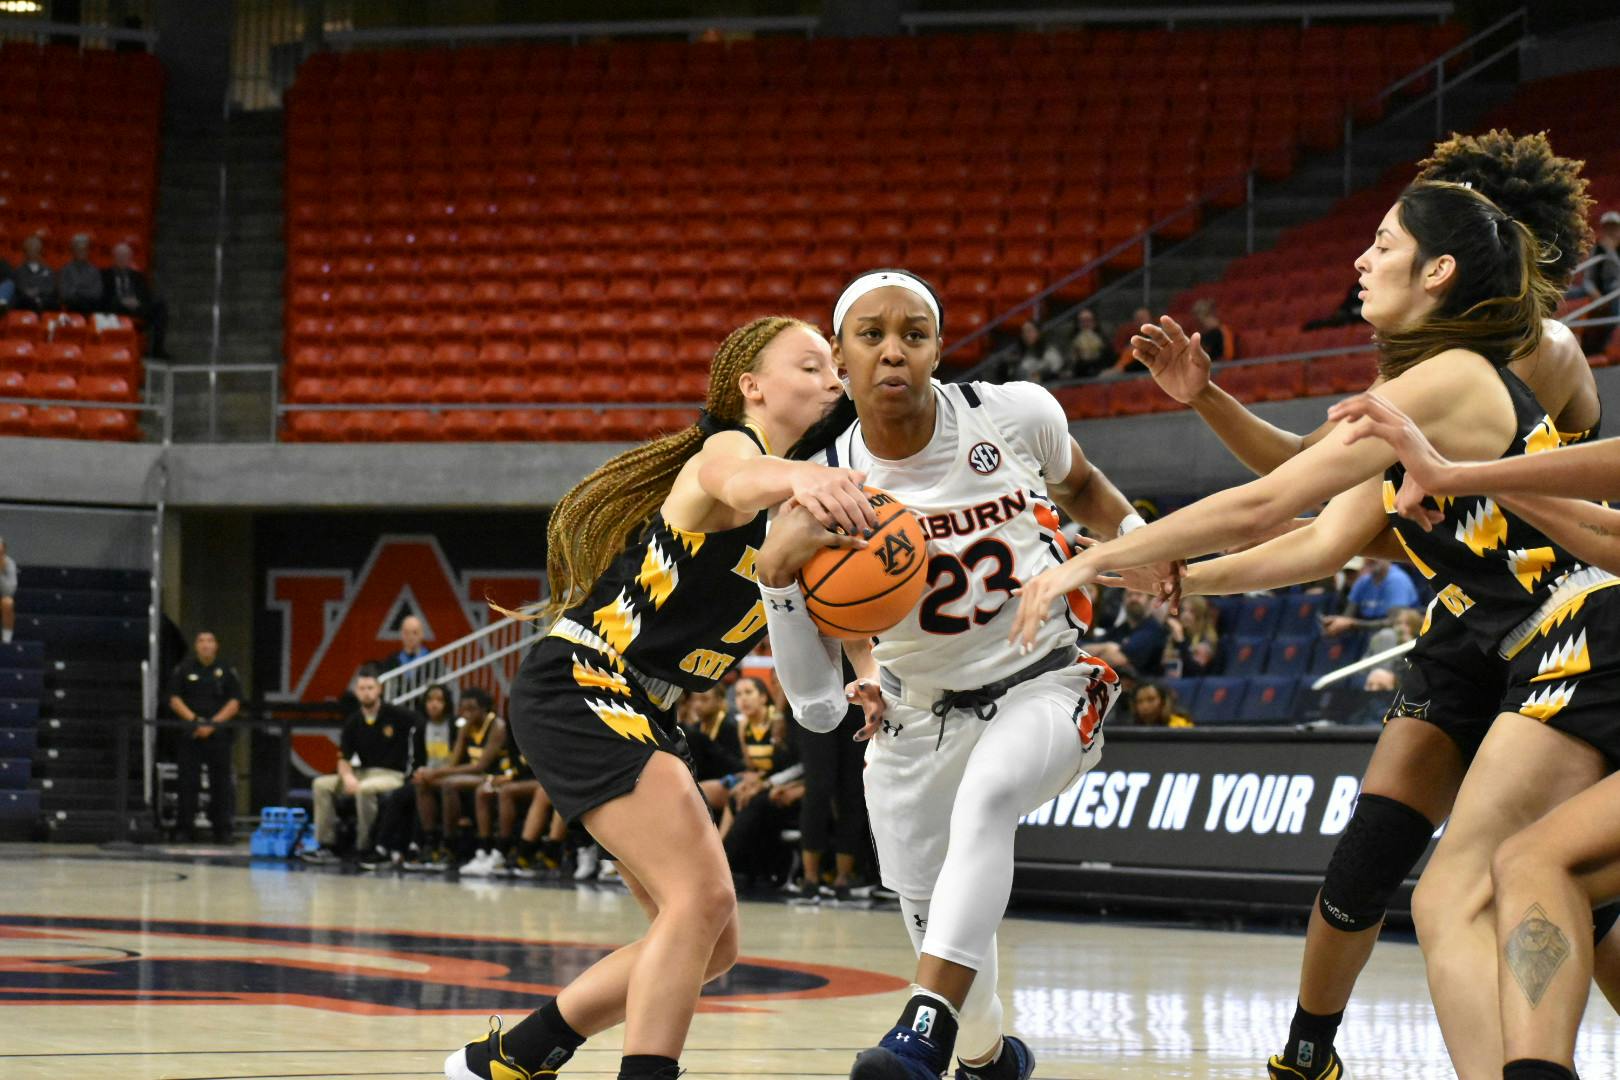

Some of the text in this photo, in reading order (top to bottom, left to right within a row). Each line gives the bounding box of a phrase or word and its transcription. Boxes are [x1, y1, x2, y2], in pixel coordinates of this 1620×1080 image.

[970, 442, 1000, 474] SEC
[918, 537, 1022, 635] 23
[1018, 771, 1364, 836] VEST IN YOUR B
